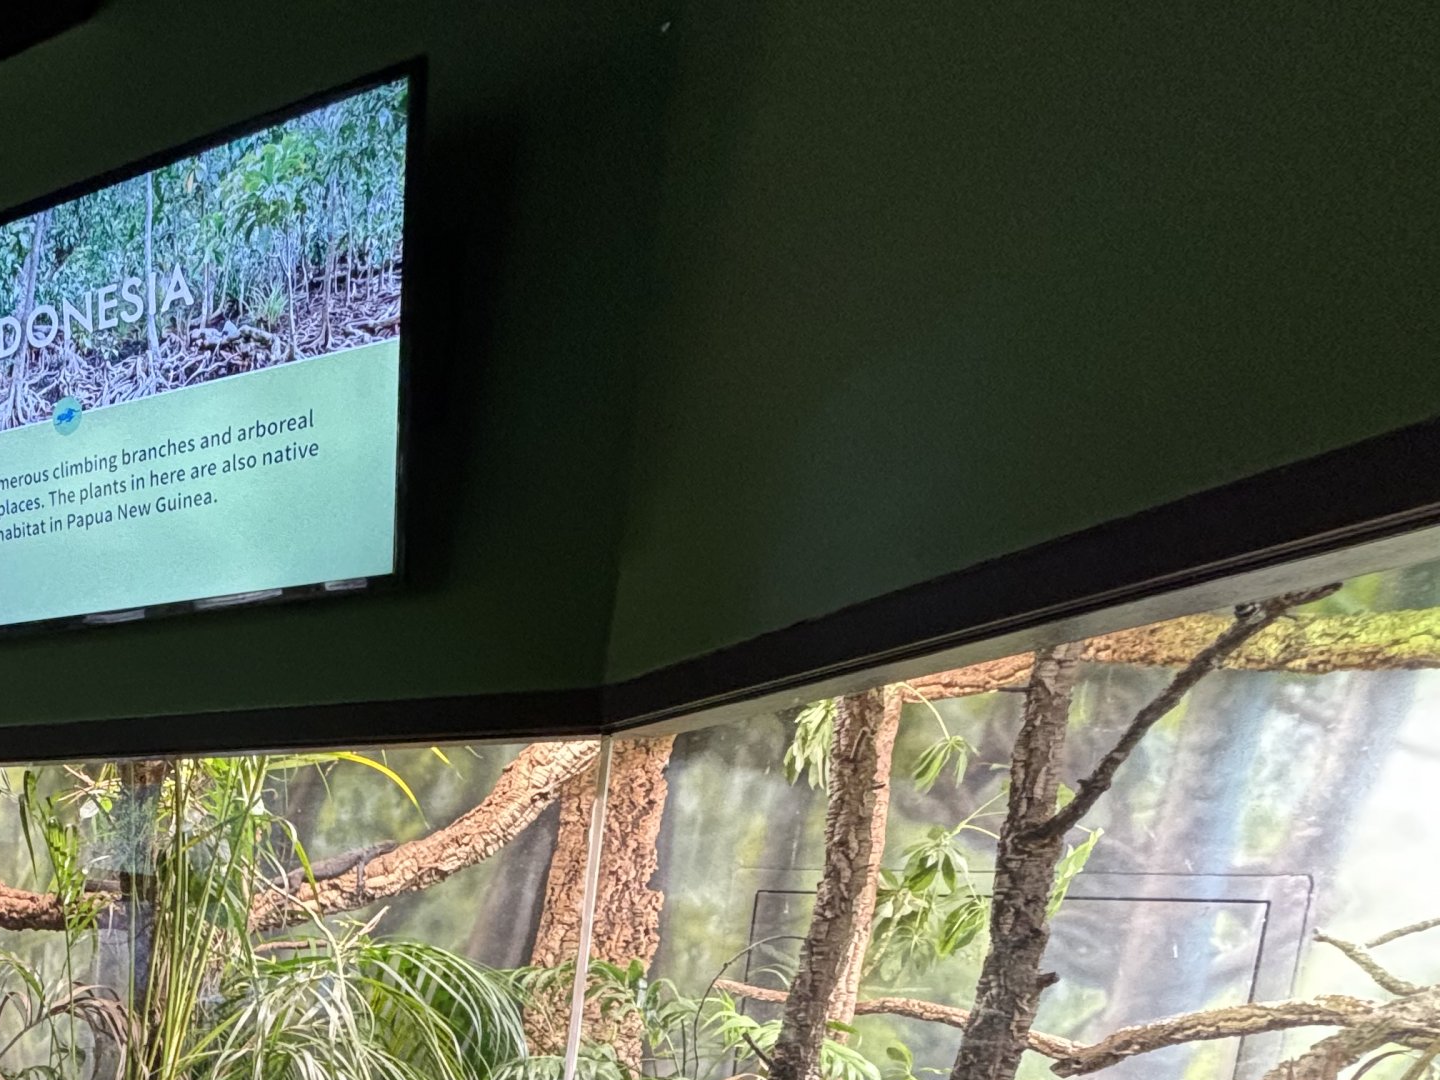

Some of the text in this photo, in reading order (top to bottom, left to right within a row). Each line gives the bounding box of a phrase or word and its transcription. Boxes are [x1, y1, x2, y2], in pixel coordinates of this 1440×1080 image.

[48, 489, 76, 507] The
[80, 480, 127, 505] plants
[131, 474, 145, 491] in
[150, 469, 186, 488] here
[190, 462, 217, 480] are
[222, 453, 257, 474] also
[262, 441, 319, 466] native
[53, 454, 117, 480] climbing
[122, 437, 195, 466] branches
[200, 426, 231, 449] and
[237, 408, 314, 442] arboreal
[50, 516, 62, 533] in
[67, 509, 113, 530] Papua
[118, 502, 151, 521] New
[155, 491, 218, 513] Guinea.
